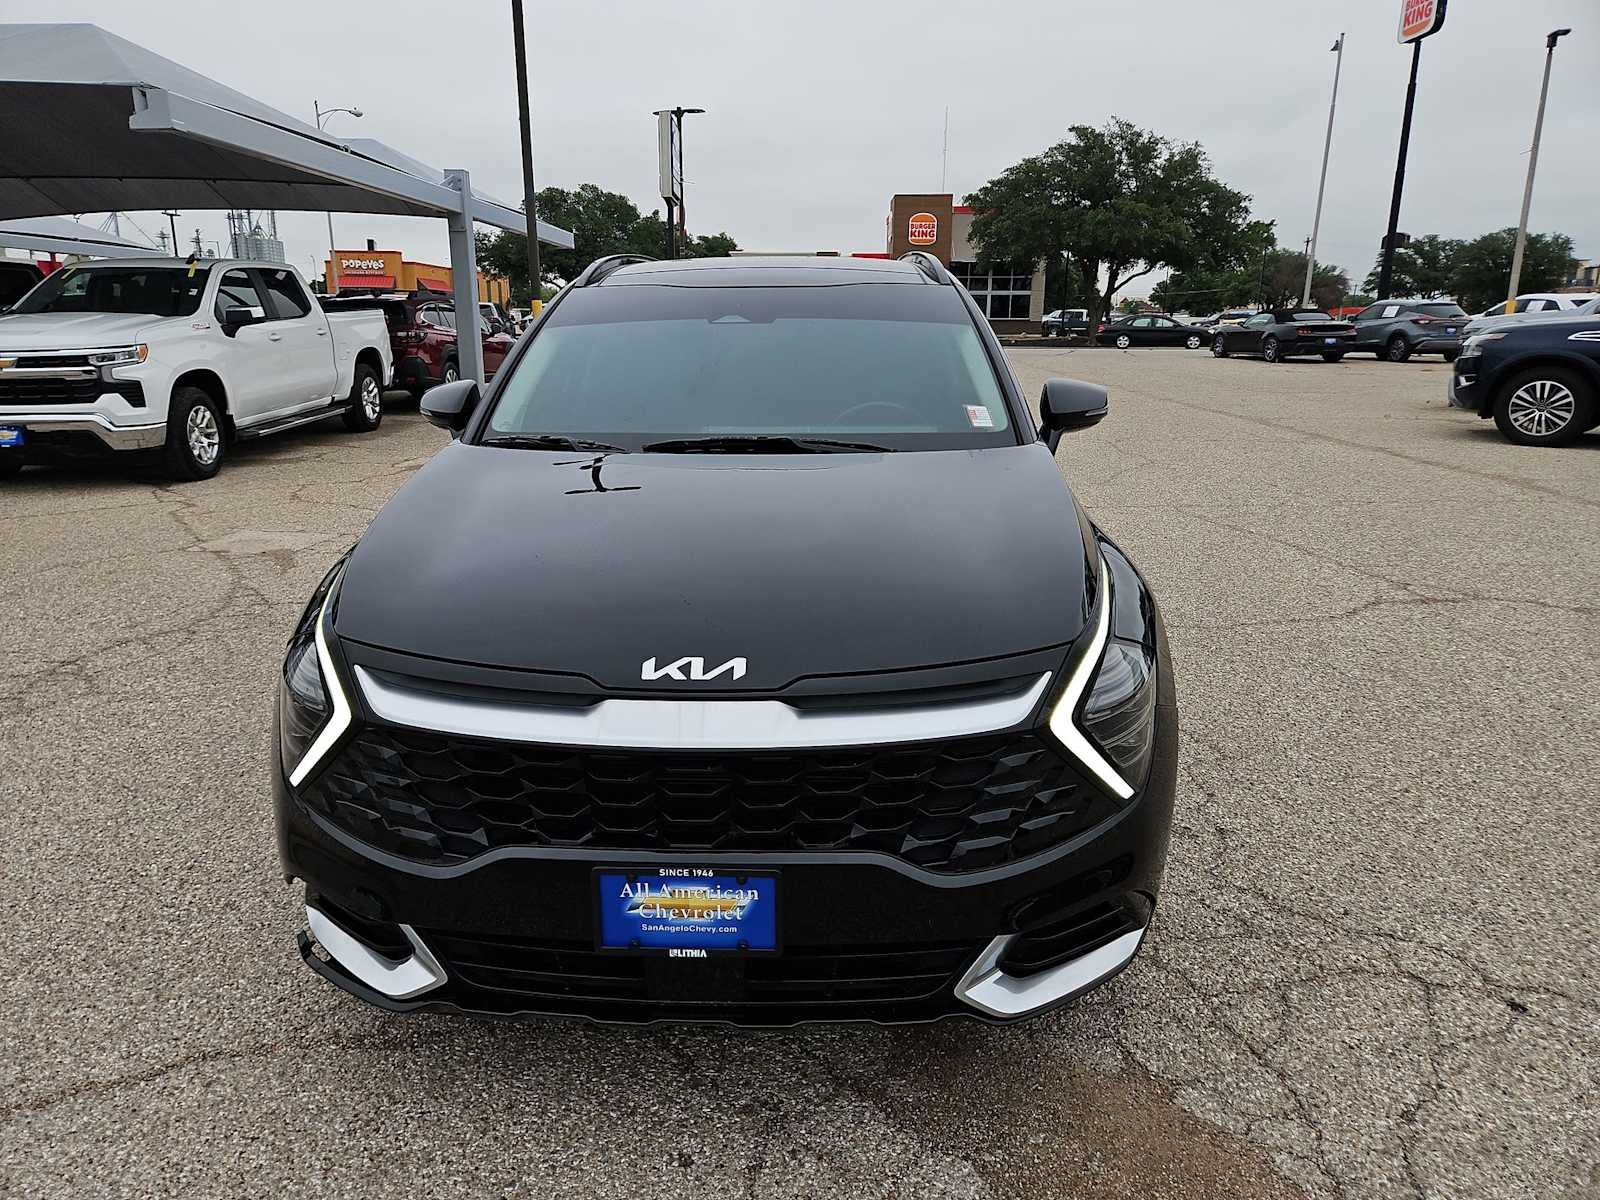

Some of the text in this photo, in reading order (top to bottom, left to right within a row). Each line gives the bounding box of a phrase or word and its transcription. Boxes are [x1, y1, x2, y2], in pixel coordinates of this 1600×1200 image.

[1403, 1, 1433, 28] KING
[910, 230, 936, 238] KING
[641, 656, 747, 681] KIA
[659, 868, 714, 878] SINCE 1946
[619, 882, 759, 900] All American
[639, 903, 743, 920] Chevrolet
[641, 923, 738, 934] SanAngeloChevy.com
[677, 949, 708, 958] LITHIA
